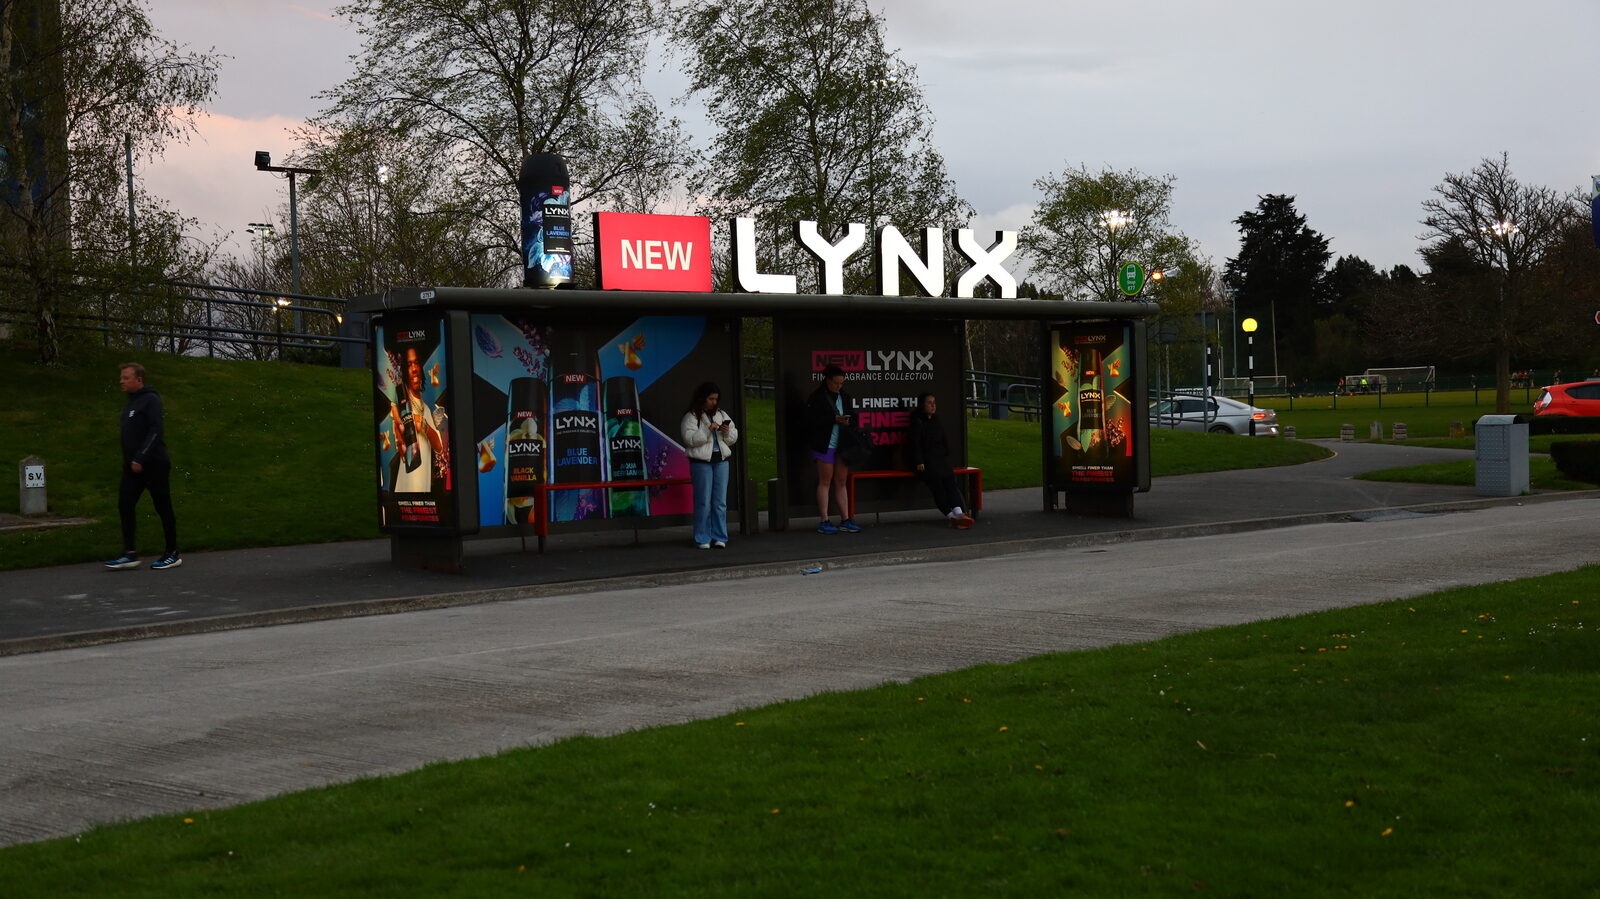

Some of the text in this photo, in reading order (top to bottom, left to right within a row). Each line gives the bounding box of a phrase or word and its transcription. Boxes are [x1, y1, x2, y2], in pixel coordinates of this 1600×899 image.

[545, 207, 569, 215] LYNX
[621, 217, 1017, 299] NEW LYNX
[408, 330, 425, 339] LYNX
[866, 350, 934, 371] LYNX
[565, 374, 584, 382] NEW
[812, 372, 934, 381] FIN AGRANCE COLLECTION
[862, 398, 899, 408] FINER
[901, 397, 918, 408] TH
[556, 416, 597, 429] LYNX
[857, 411, 912, 429] FINE
[509, 442, 541, 453] LYNX
[612, 439, 641, 449] LYNX
[566, 447, 588, 456] BLUE
[556, 457, 598, 466] LAVENDER
